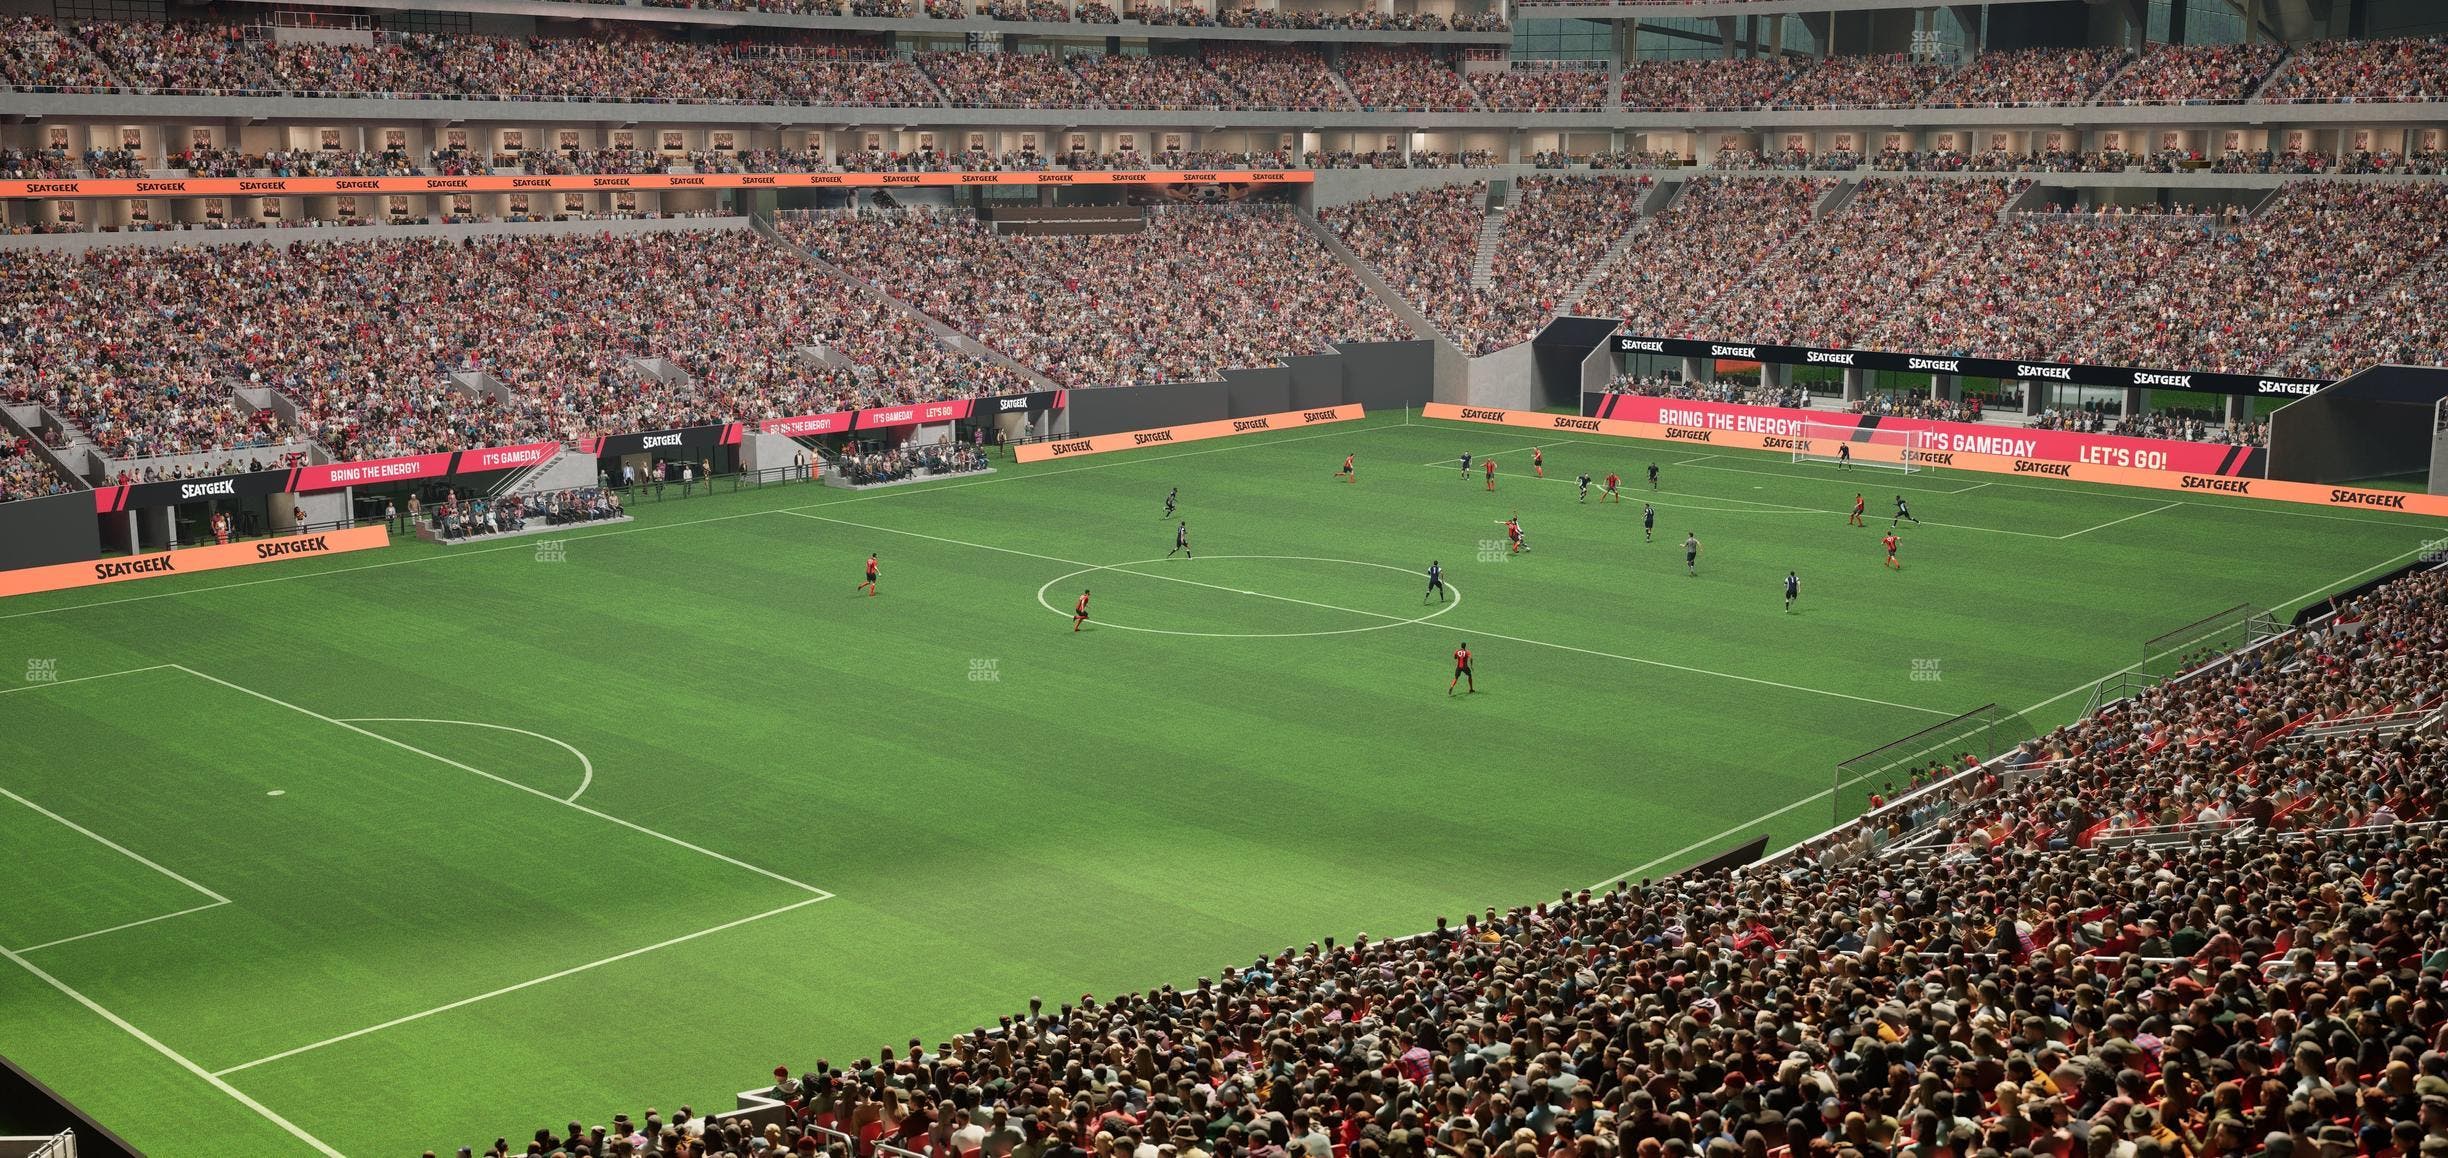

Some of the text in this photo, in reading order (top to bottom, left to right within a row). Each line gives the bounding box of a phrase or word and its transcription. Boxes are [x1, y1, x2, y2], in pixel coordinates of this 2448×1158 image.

[427, 180, 468, 188] SEATGEEK
[513, 179, 551, 187] SEATGEEK
[594, 178, 630, 186] SEATGEEK
[670, 177, 705, 185] SEATGEEK
[743, 176, 775, 184] SEATGEEK
[883, 175, 920, 183] SEATGEEK
[1039, 174, 1073, 182] SEATGEEK
[1253, 173, 1284, 181] SEATGEEK
[27, 184, 79, 193] SEATGEEK
[137, 183, 185, 192] SEATGEEK
[240, 181, 286, 191] SEATGEEK
[336, 181, 379, 189] SEATGEEK
[1622, 339, 1663, 352] SEATGEEK
[1711, 345, 1756, 359] SEATGEEK
[1807, 351, 1855, 365] SEATGEEK
[1908, 358, 1959, 372] SEATGEEK
[2017, 365, 2072, 380] SEATGEEK
[2134, 372, 2191, 388] SEATGEEK
[2258, 380, 2320, 395] SEATGEEK
[1000, 397, 1028, 410] SEATGEEK
[873, 405, 953, 424] IT'S GAMEDAY LET'S GO!
[1304, 409, 1338, 423] SEATGEEK
[1461, 408, 1504, 422] SEATGEEK
[770, 418, 831, 435] BRNG THE ENERGY!
[1233, 417, 1269, 432] SEATGEEK
[1554, 417, 1601, 431] SEATGEEK
[1659, 408, 1801, 436] BRING THE ENERGY!
[643, 432, 682, 449] SEATGEEK
[1134, 430, 1173, 445] SEATGEEK
[1665, 427, 1712, 442] SEATGEEK
[1052, 440, 1093, 455] SEATGEEK
[1763, 436, 1812, 451] SEATGEEK
[1918, 431, 2168, 470] IT'S GAMEDAY LET'S GO!
[331, 449, 541, 482] BRING THE ENERGY! IT'S GAMEDAY
[2014, 460, 2071, 477] SEATGEEK
[181, 479, 235, 499] SEATGEEK
[2181, 475, 2250, 494] SEATGEEK
[2330, 489, 2406, 509] SEATGEEK
[257, 536, 329, 559] SEATGEEK
[95, 555, 175, 580] SEATGEEK
